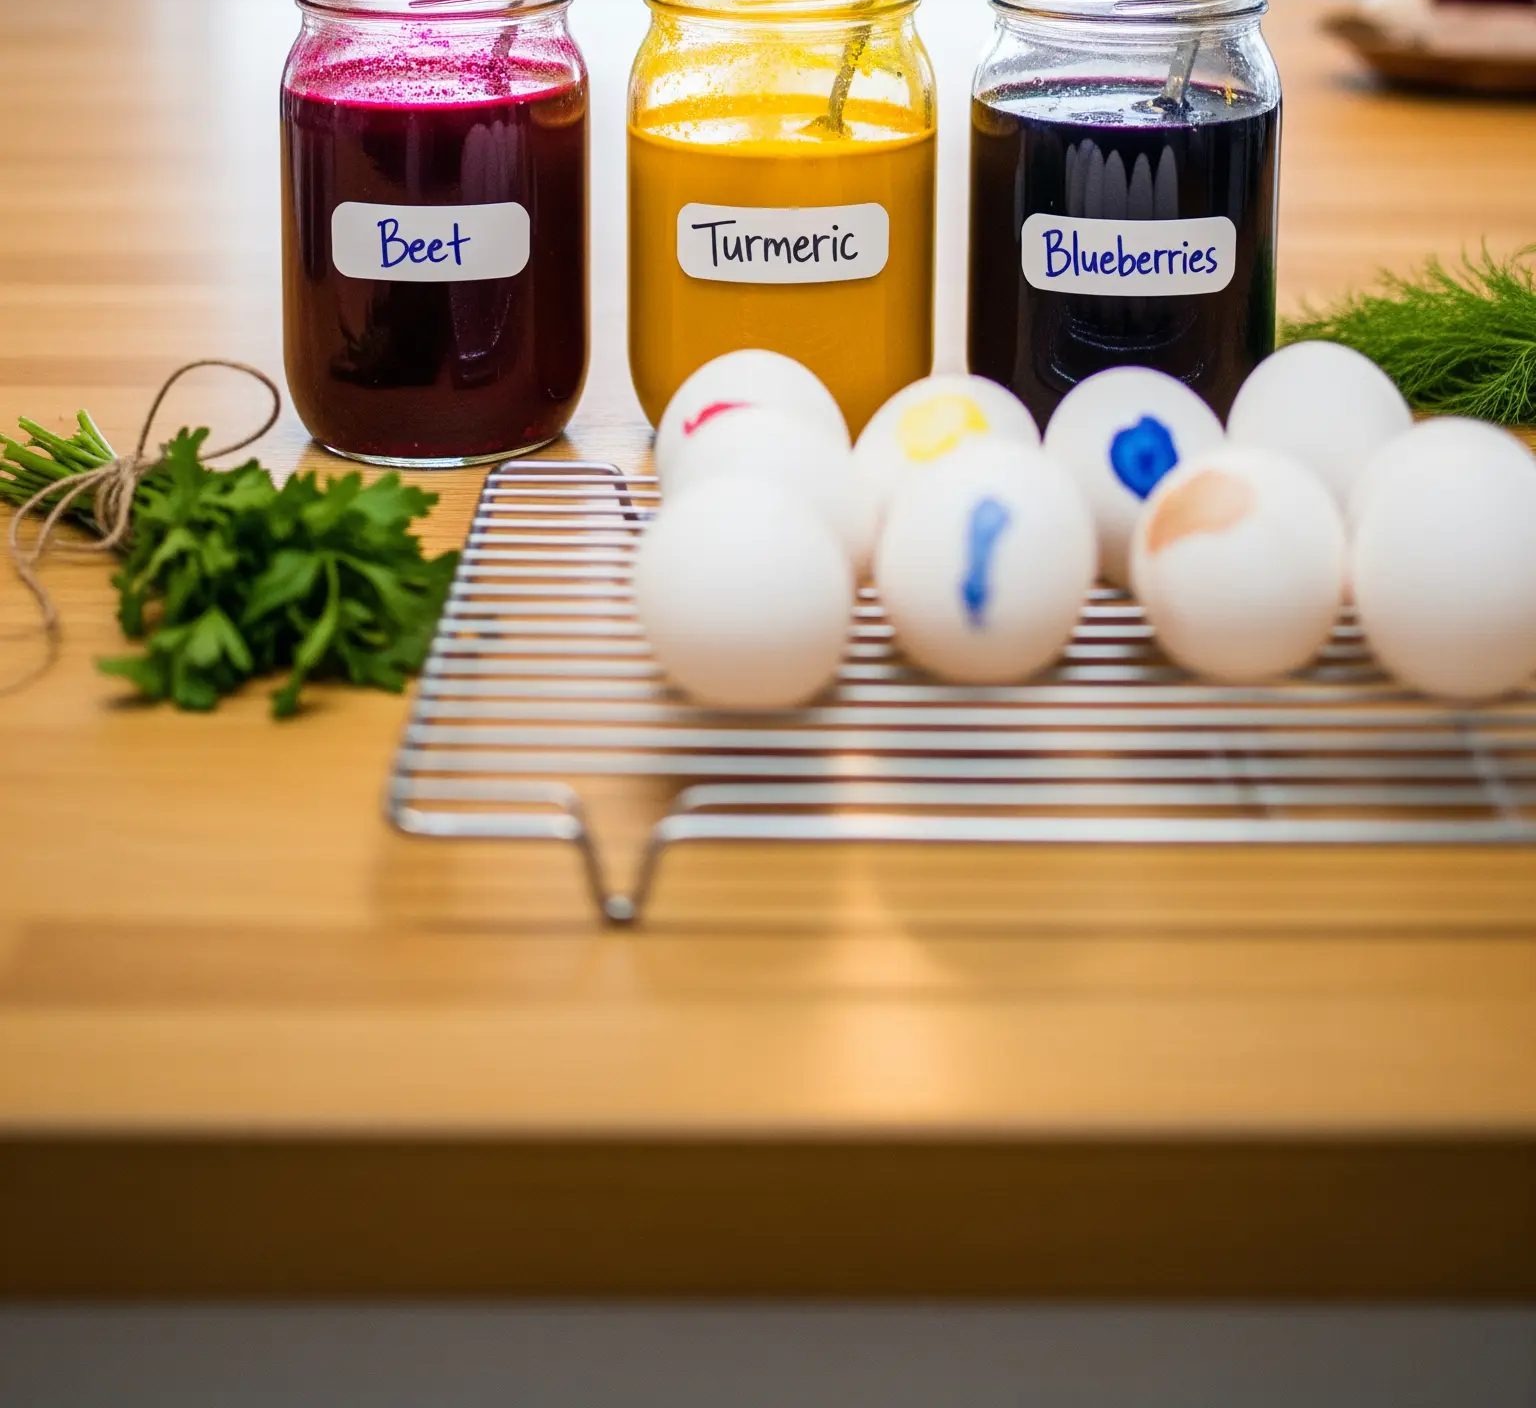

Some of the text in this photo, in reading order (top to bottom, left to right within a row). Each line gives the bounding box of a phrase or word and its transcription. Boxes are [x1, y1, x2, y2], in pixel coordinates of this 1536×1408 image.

[377, 218, 472, 268] Beet
[691, 219, 859, 267] Turmeric
[1041, 228, 1218, 278] Blueberries
